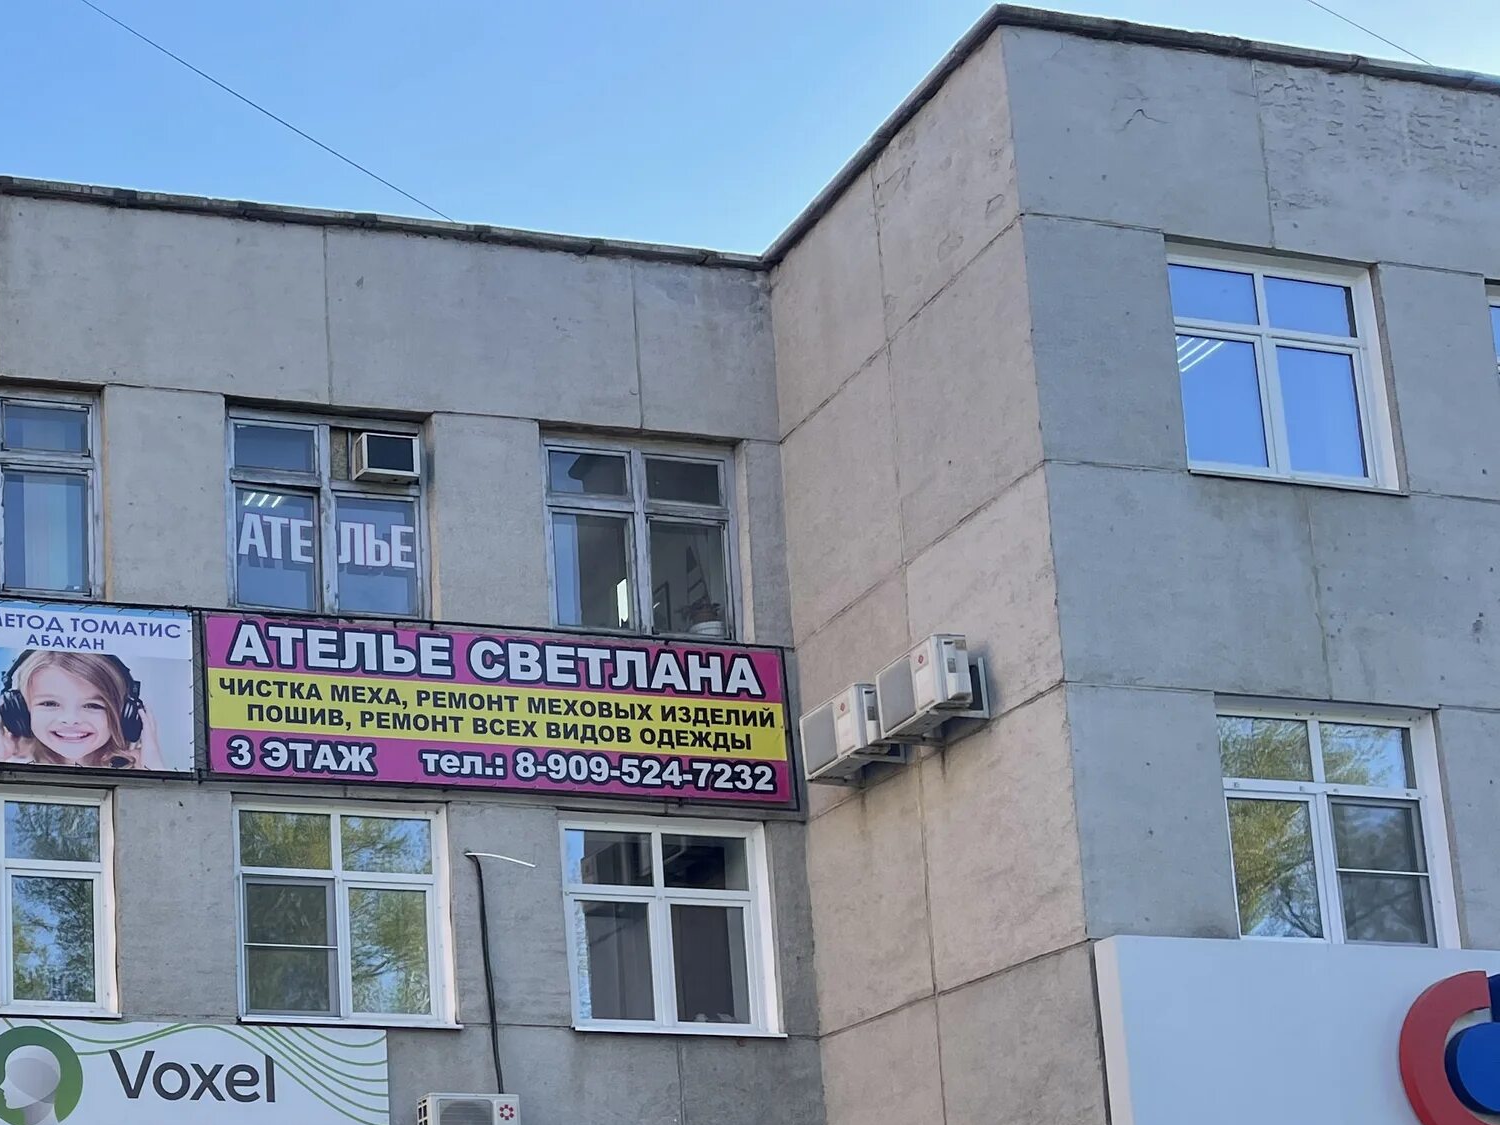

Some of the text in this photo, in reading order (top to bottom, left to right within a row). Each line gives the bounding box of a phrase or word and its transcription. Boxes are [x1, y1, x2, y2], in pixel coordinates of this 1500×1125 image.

[238, 512, 415, 568] АТЕЛЬЕ
[26, 633, 105, 651] АБАКАН
[70, 618, 181, 639] ТОМАТИС
[228, 622, 764, 697] АТЕЛЬЕ СВЕТЛАНА
[219, 677, 775, 729] ЧИСТКА МЕХА, РЕМОНТ МЕХОВЫХ ИЗДЕЛИЙ
[247, 703, 752, 752] ПОШИВ, РЕМОНТ ВСЕХ ВИДОВ ОДЕЖДЫ
[229, 738, 775, 792] 3 ЭТАЖ тел.: 8-909-524-7232
[108, 1049, 277, 1103] Voxel
